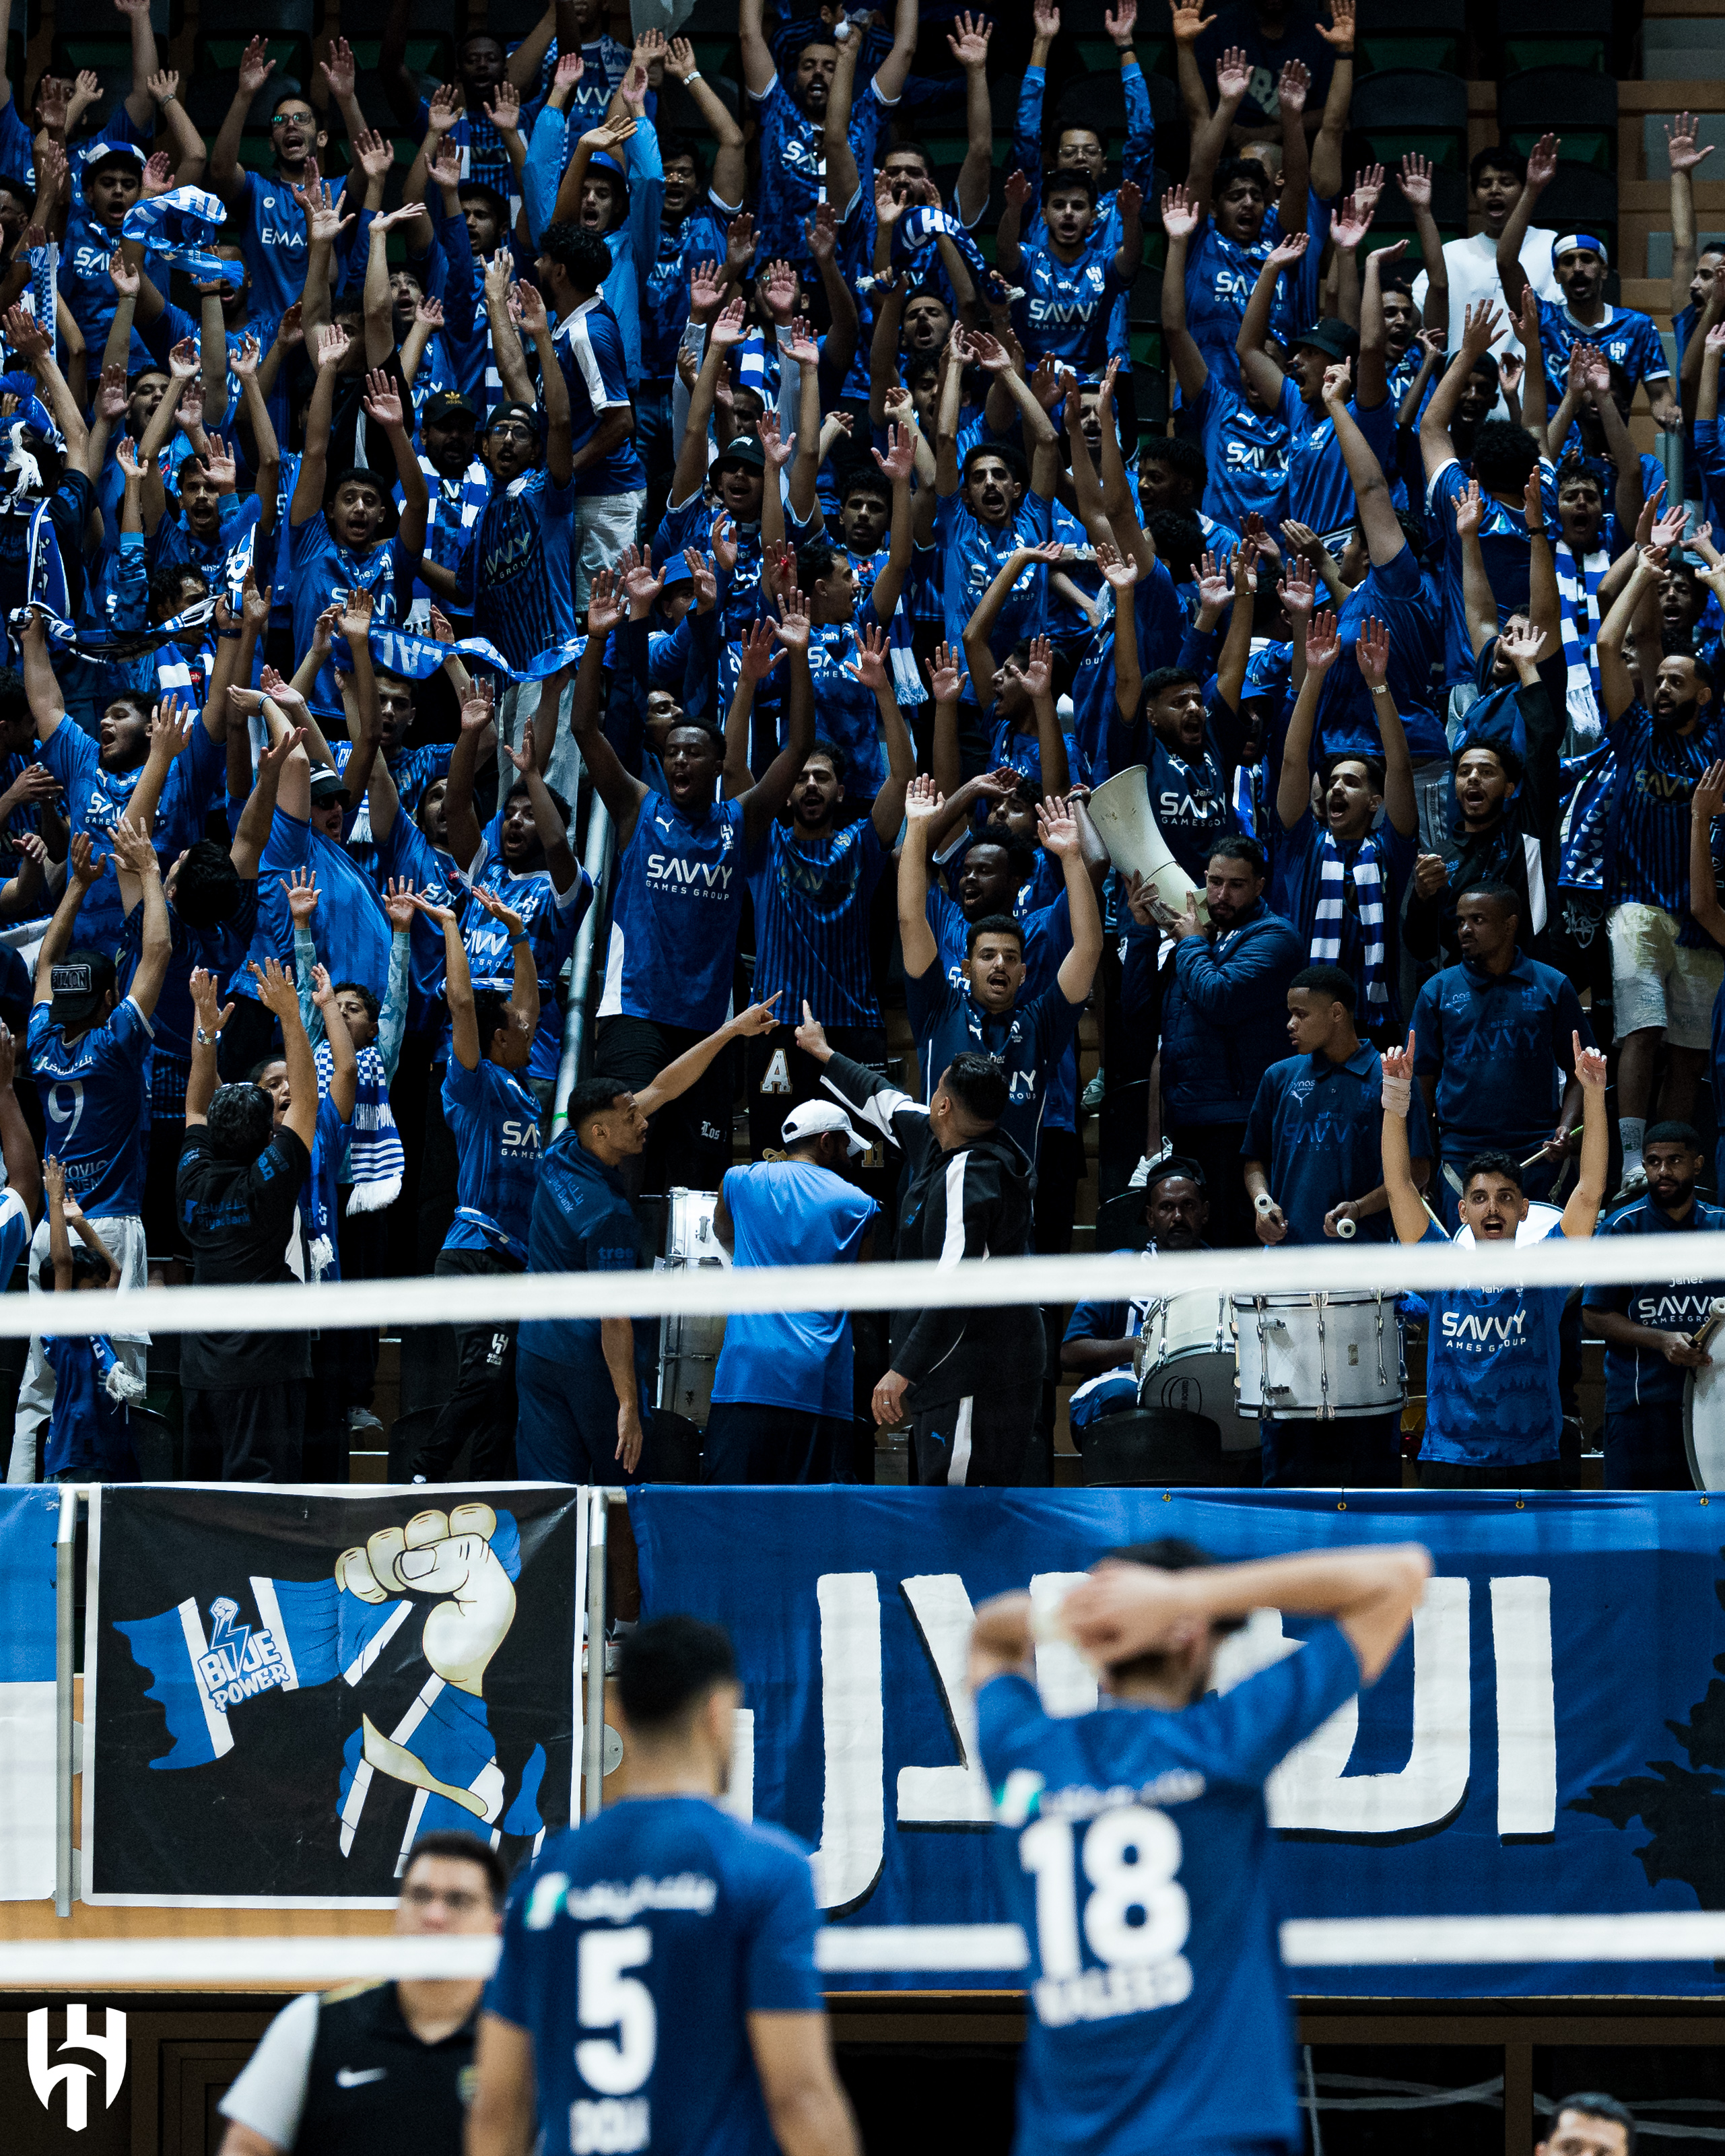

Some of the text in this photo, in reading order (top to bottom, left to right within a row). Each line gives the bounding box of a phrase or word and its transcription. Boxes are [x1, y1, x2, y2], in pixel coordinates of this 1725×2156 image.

[1214, 294, 1246, 306] GAME
[813, 670, 848, 679] AMES
[647, 853, 733, 890] SAVVY
[645, 879, 730, 902] GAMES GROUP
[479, 957, 510, 970] GROU
[759, 1048, 794, 1096] A
[1008, 1091, 1038, 1101] ROUP
[48, 1080, 84, 1155] 9
[1637, 1295, 1718, 1318] SAVV
[1687, 1314, 1710, 1324] GRO
[1442, 1309, 1526, 1341] SAVVY
[1446, 1339, 1482, 1353] AMES
[199, 1629, 281, 1691] BLUE
[211, 1664, 290, 1712] POWER
[1019, 1803, 1192, 1982] 18
[572, 1924, 658, 2098] 5
